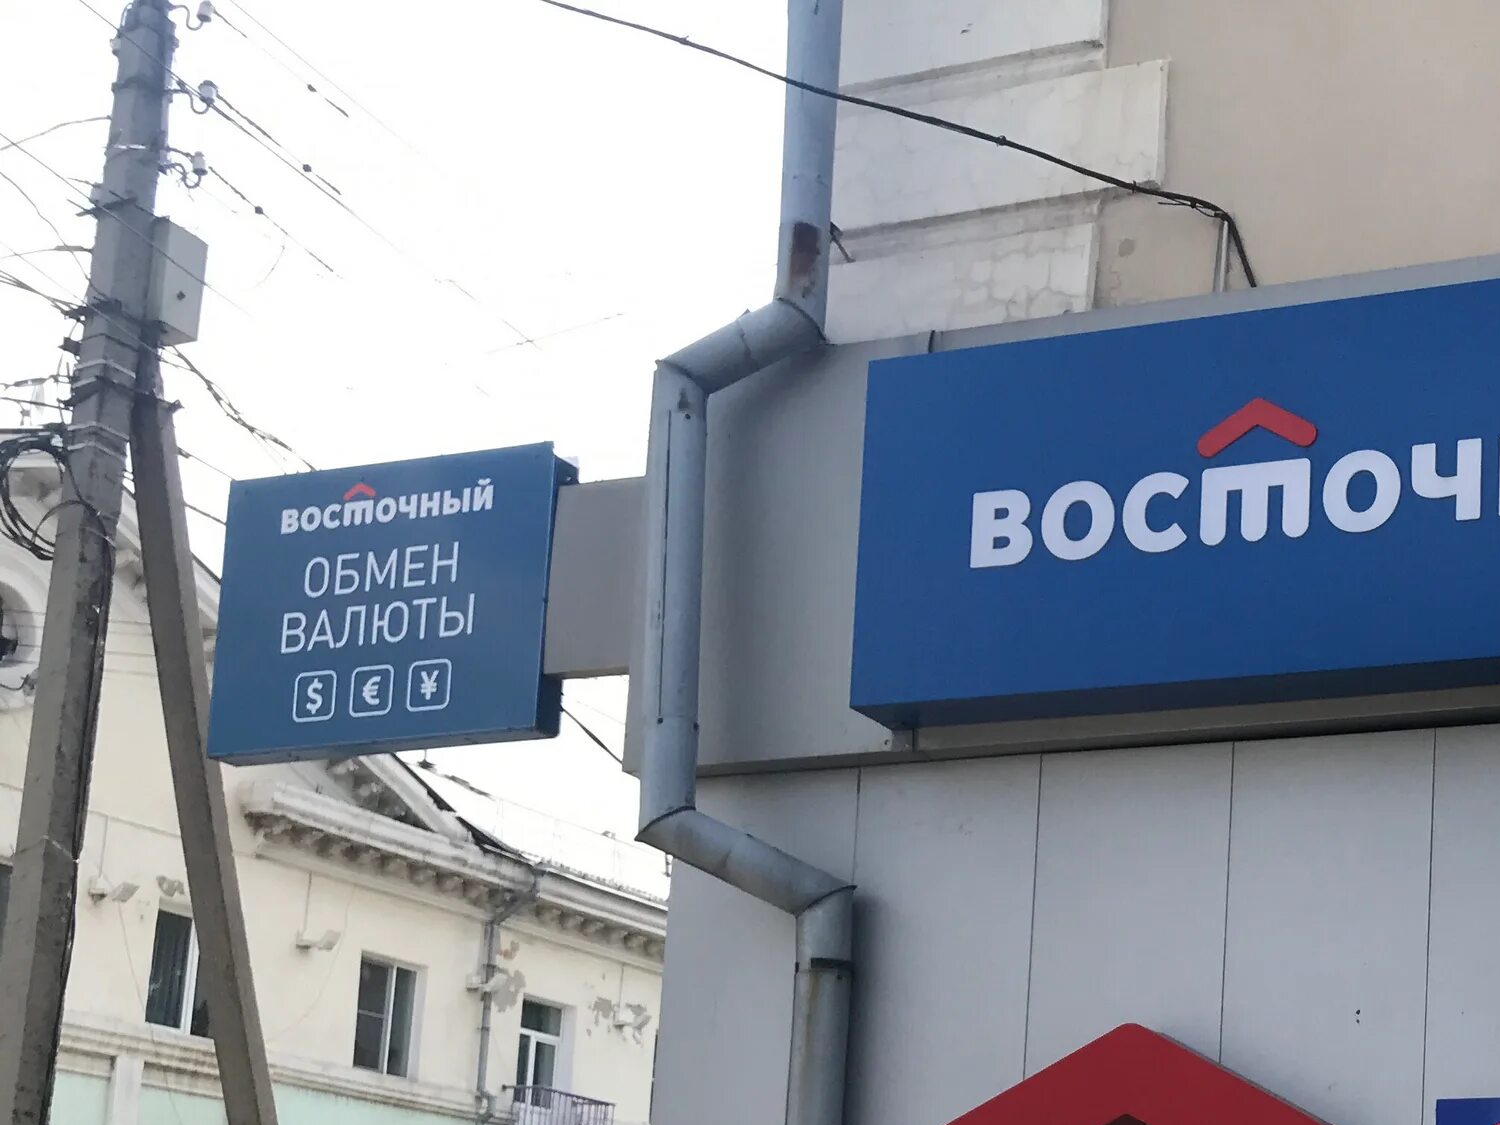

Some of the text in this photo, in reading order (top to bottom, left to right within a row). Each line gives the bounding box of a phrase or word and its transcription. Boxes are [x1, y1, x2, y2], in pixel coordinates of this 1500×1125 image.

[280, 478, 495, 535] ВОСТОЧНЫЙ
[303, 540, 461, 599] ОБМЕН
[280, 593, 476, 655] ВАЛЮТЫ
